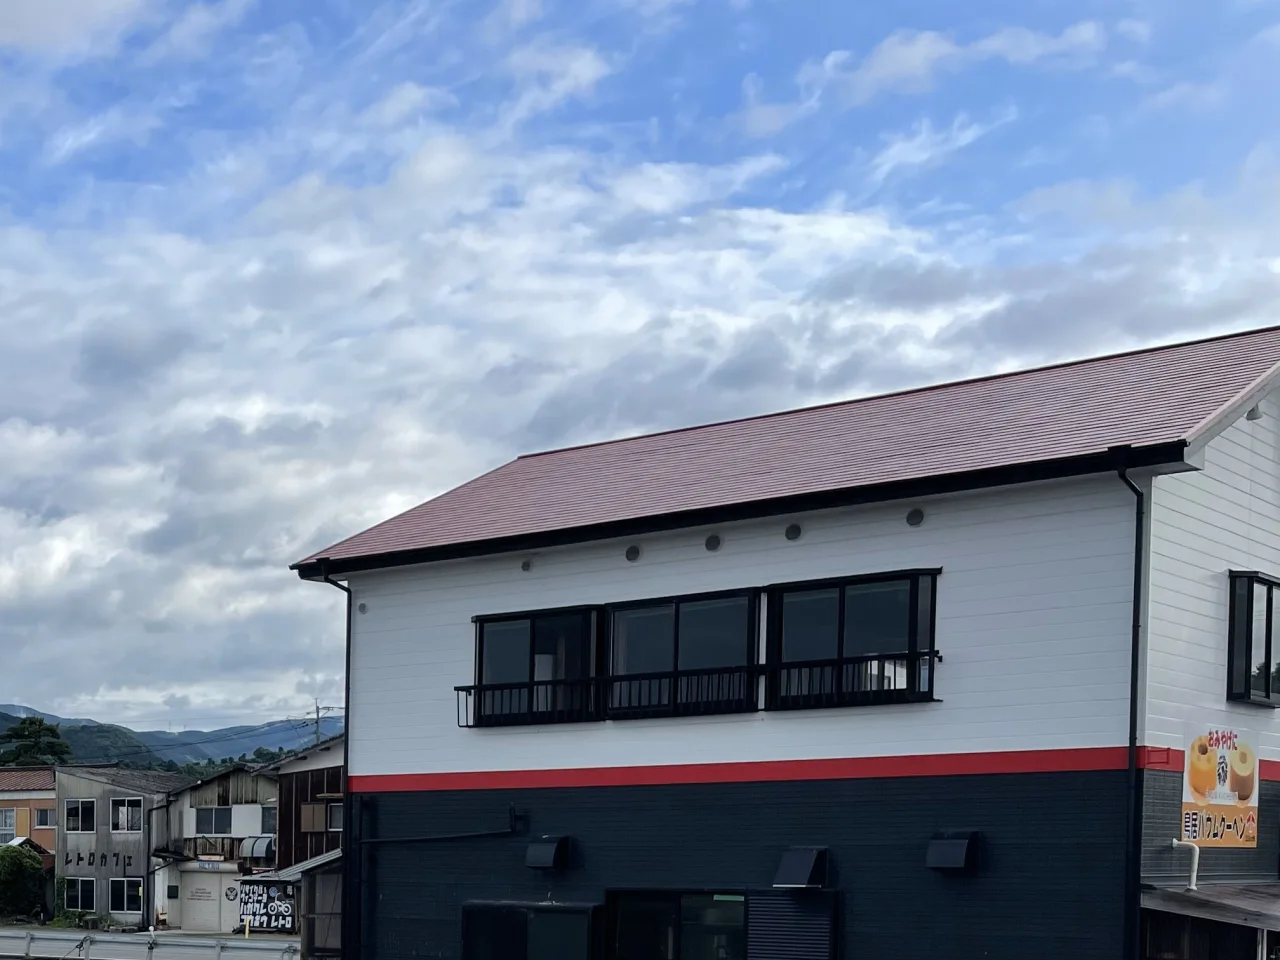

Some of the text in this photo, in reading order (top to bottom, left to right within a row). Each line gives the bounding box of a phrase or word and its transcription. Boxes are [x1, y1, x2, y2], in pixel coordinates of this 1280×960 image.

[64, 852, 133, 867] レトロカフェ
[271, 915, 292, 928] レトロ
